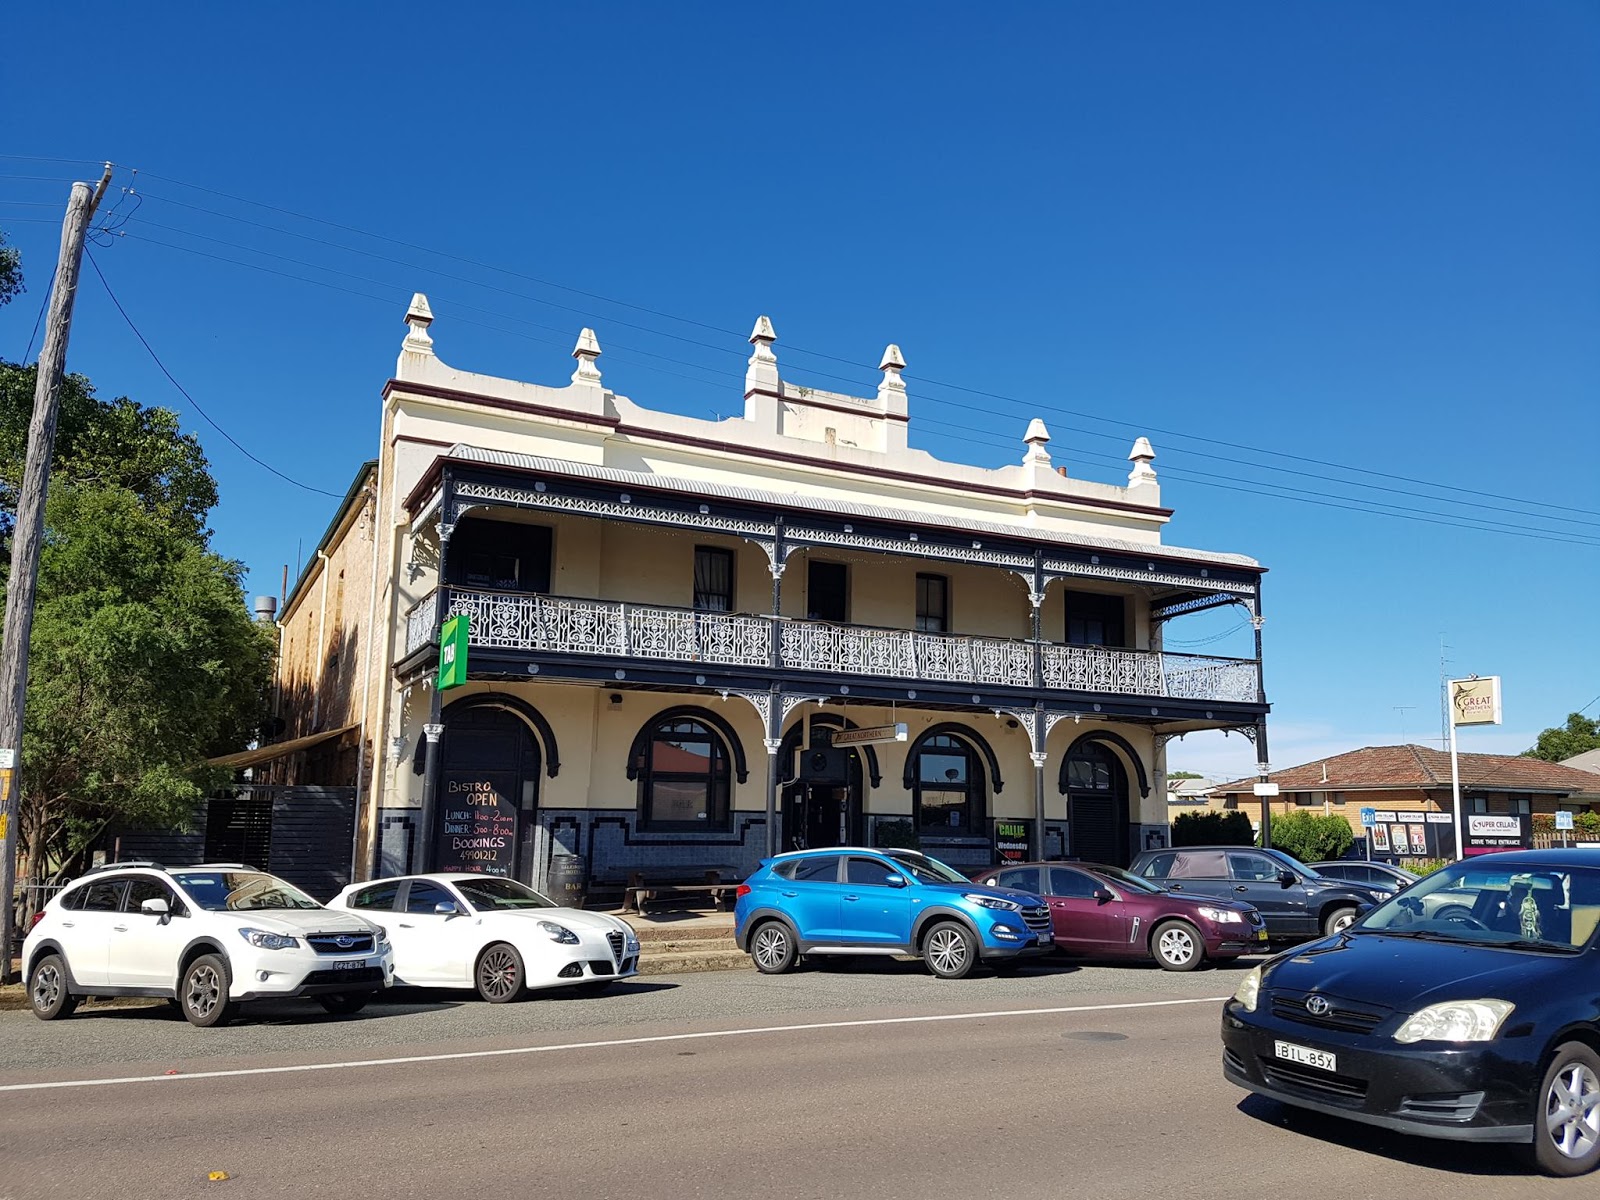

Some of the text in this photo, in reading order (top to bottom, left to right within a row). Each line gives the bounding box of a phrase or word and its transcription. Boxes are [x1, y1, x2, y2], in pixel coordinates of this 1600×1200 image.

[443, 643, 455, 665] TAB
[1463, 696, 1491, 706] GREAT
[448, 780, 492, 793] BISTRO
[466, 793, 497, 807] OPEN
[1362, 811, 1374, 822] Exit
[1496, 820, 1518, 829] CELLARS
[452, 837, 506, 850] BOOKINGS
[997, 842, 1028, 850] Wednesday
[465, 864, 482, 872] HOUR
[565, 882, 582, 890] BAR
